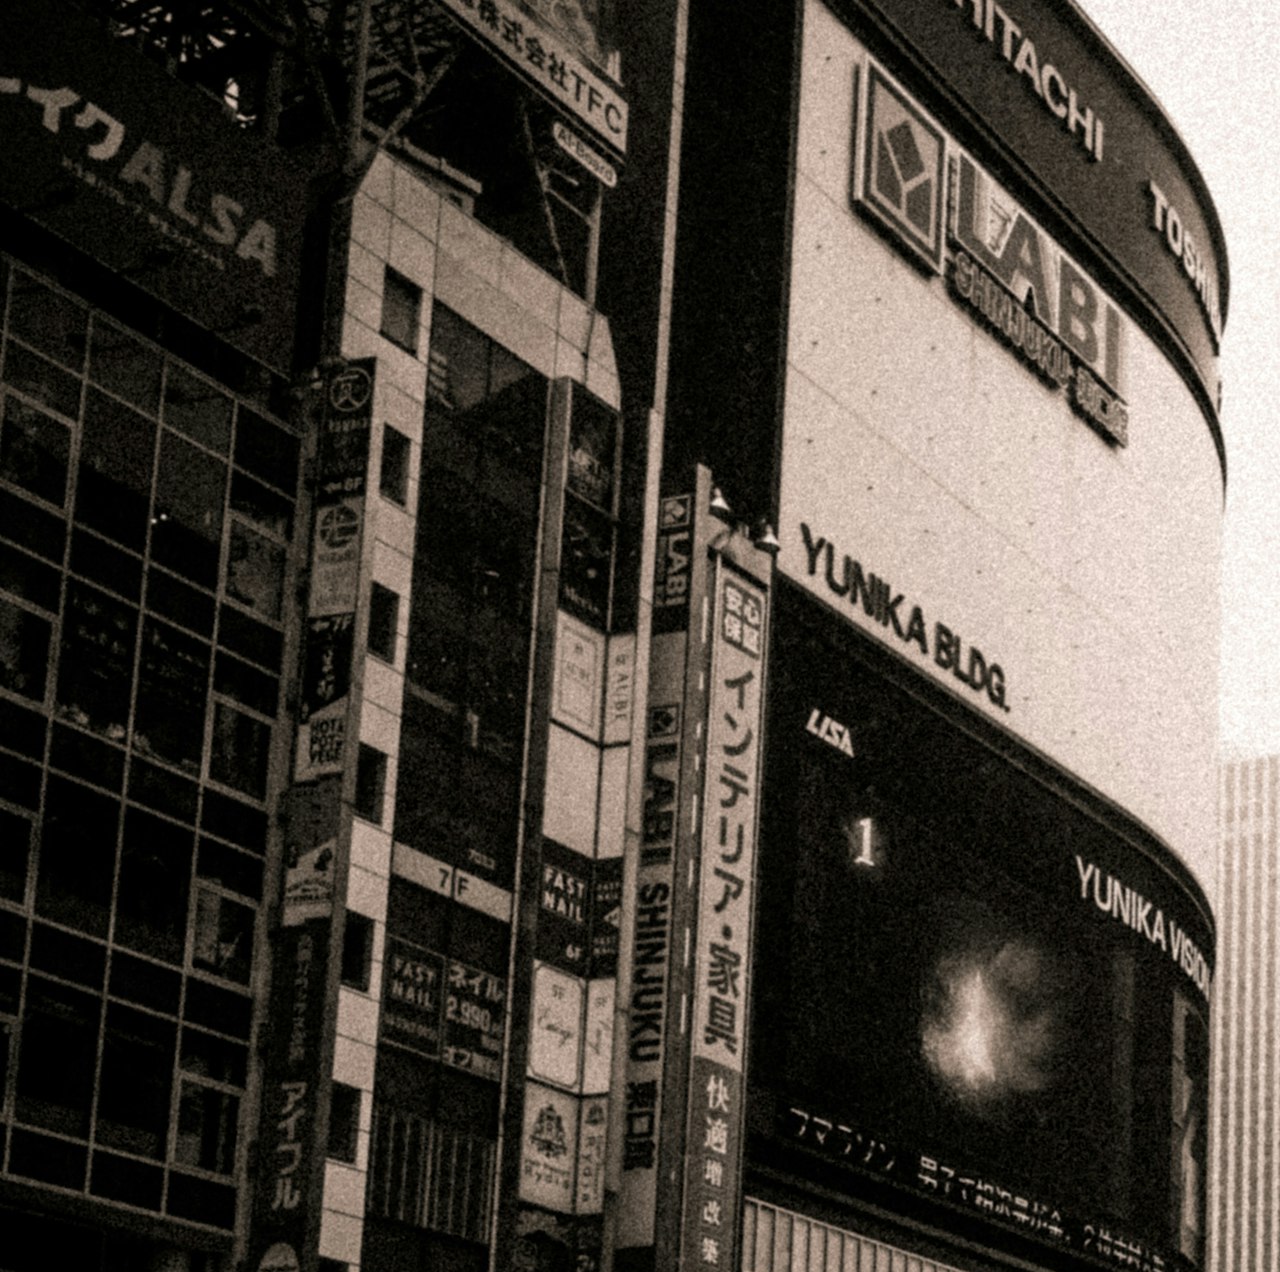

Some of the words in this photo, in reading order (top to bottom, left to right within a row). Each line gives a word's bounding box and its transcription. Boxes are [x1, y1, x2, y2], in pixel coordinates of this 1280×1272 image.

[800, 521, 929, 656] YUNIKA
[934, 620, 1011, 714] BLDG.
[630, 882, 671, 1062] SHINJUKU
[1075, 855, 1167, 951] YUNIKA
